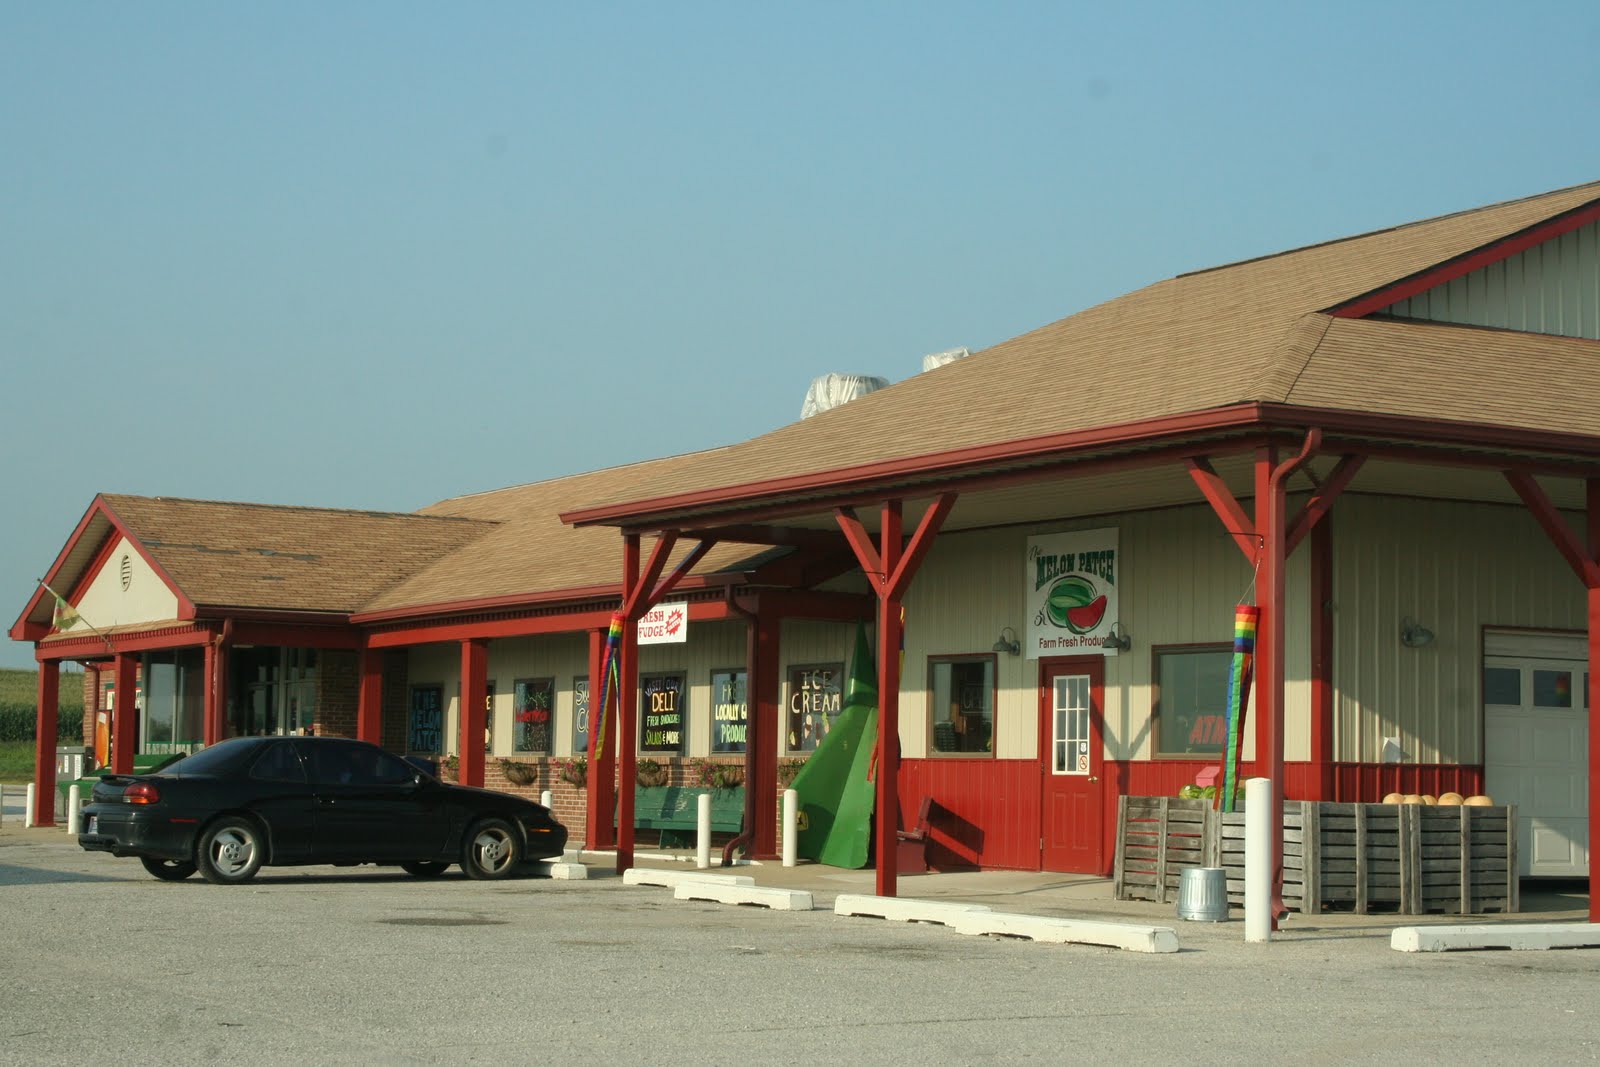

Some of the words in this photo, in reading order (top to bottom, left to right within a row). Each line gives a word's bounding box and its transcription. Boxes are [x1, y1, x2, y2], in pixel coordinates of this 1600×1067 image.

[1035, 553, 1076, 592] MELON
[1078, 549, 1115, 587] PATCH
[639, 611, 664, 624] RESH
[639, 625, 664, 639] FUDGE
[1039, 637, 1057, 649] Farm
[1058, 635, 1079, 648] Fresh
[801, 669, 832, 690] ICE
[652, 691, 675, 713] DELI
[715, 703, 739, 721] LOCALLY
[791, 690, 840, 714] CREAM
[666, 730, 680, 745] MORE
[720, 723, 747, 743] PRODUC
[1189, 714, 1226, 745] ATM
